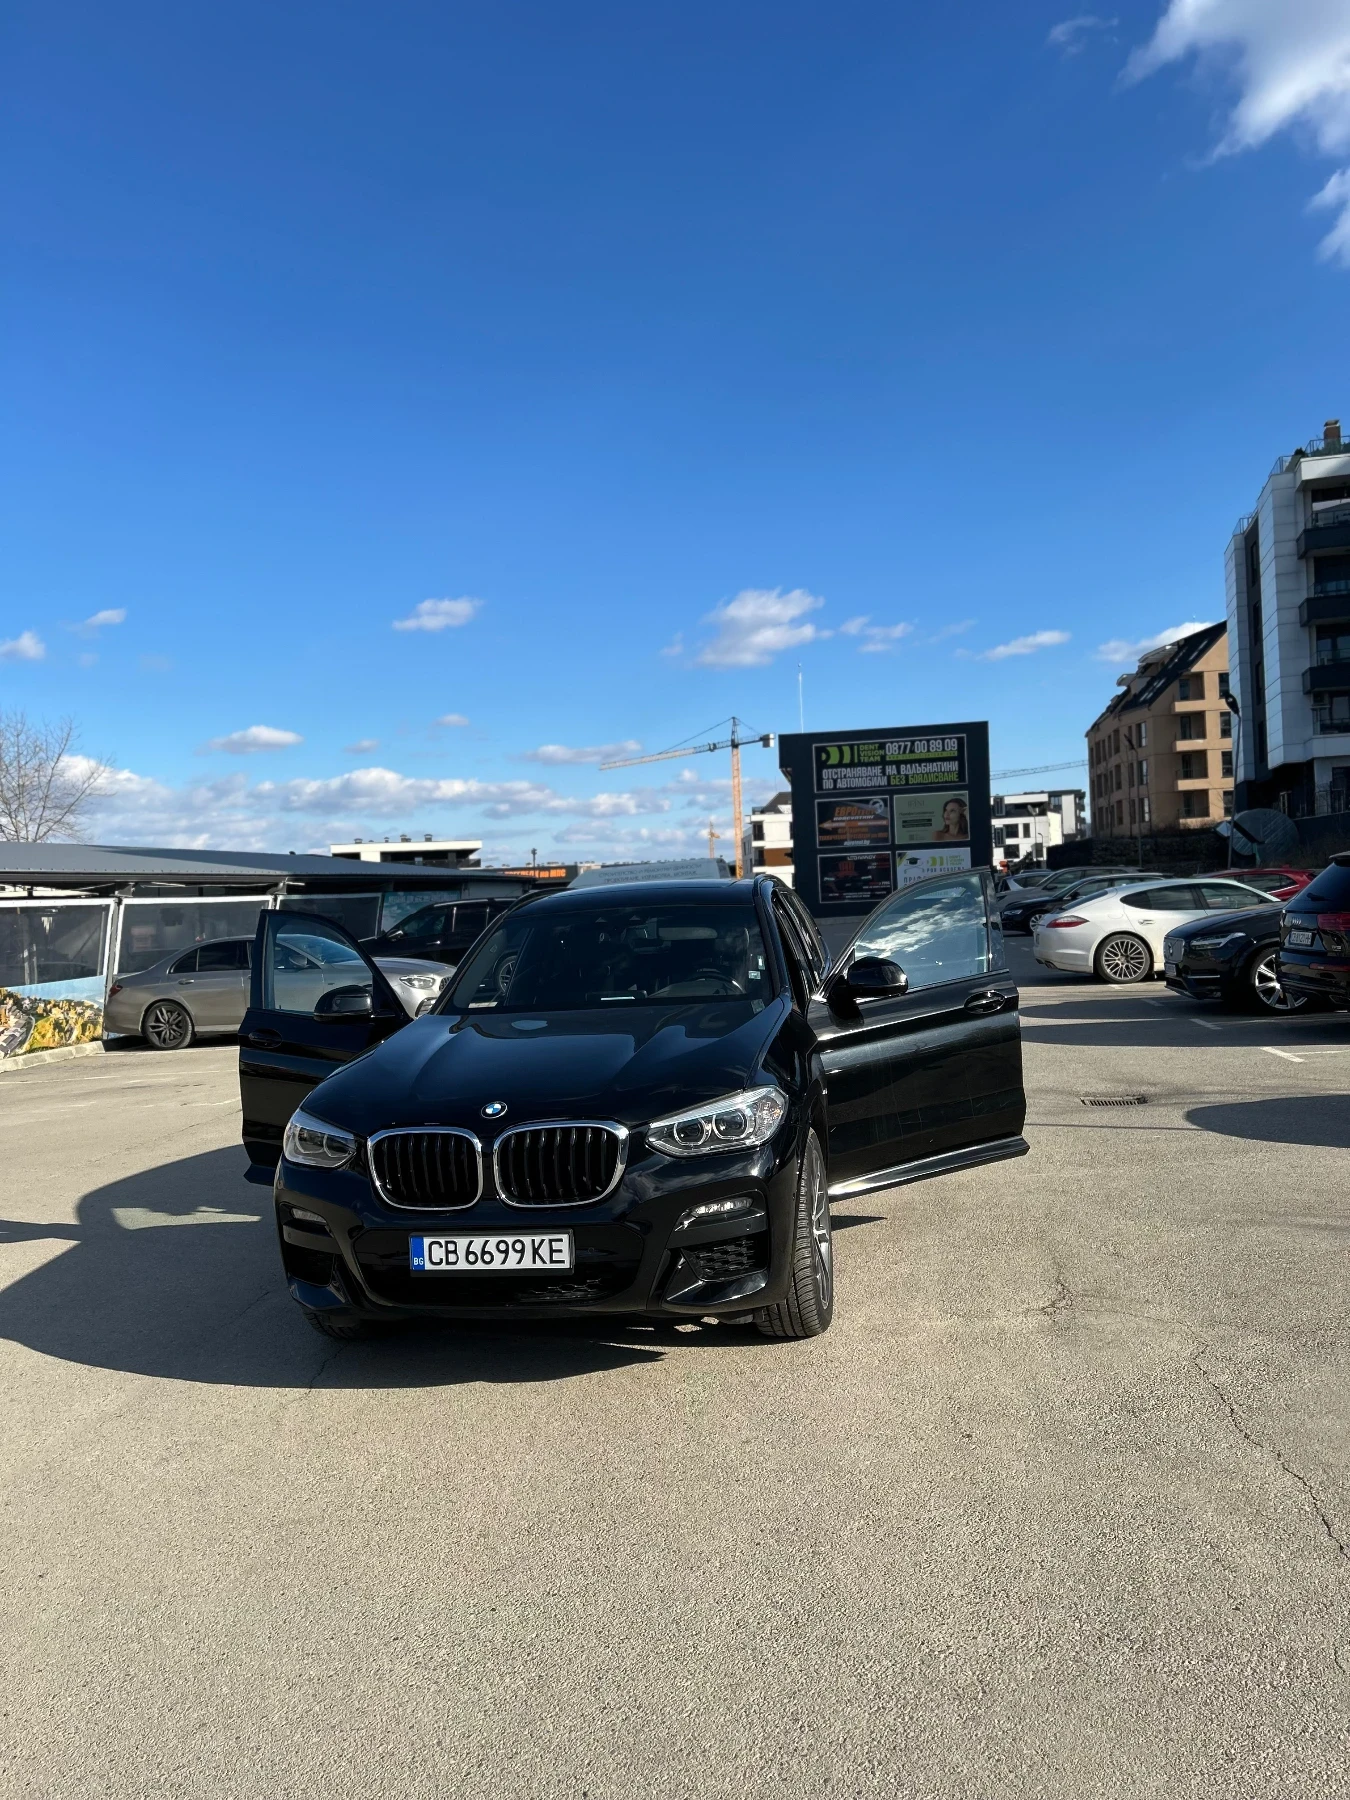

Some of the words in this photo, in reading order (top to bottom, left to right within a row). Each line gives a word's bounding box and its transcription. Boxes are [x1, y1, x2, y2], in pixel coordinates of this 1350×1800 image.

[860, 749, 885, 757] VISION
[886, 742, 911, 755] 0877
[914, 740, 927, 753] 00
[929, 739, 942, 752] 89
[944, 738, 957, 751] 09
[822, 765, 883, 780] ОТСТРАНЯВАНЕ
[886, 765, 897, 776] НА
[900, 761, 959, 775] ВДЛЪБНАТИНИ
[822, 779, 834, 790] ПО
[836, 776, 887, 789] АВТОМОБИЛИ
[890, 775, 906, 785] БЕЗ
[908, 771, 959, 784] БОЯДИСВАНЕ
[413, 1257, 424, 1266] BG
